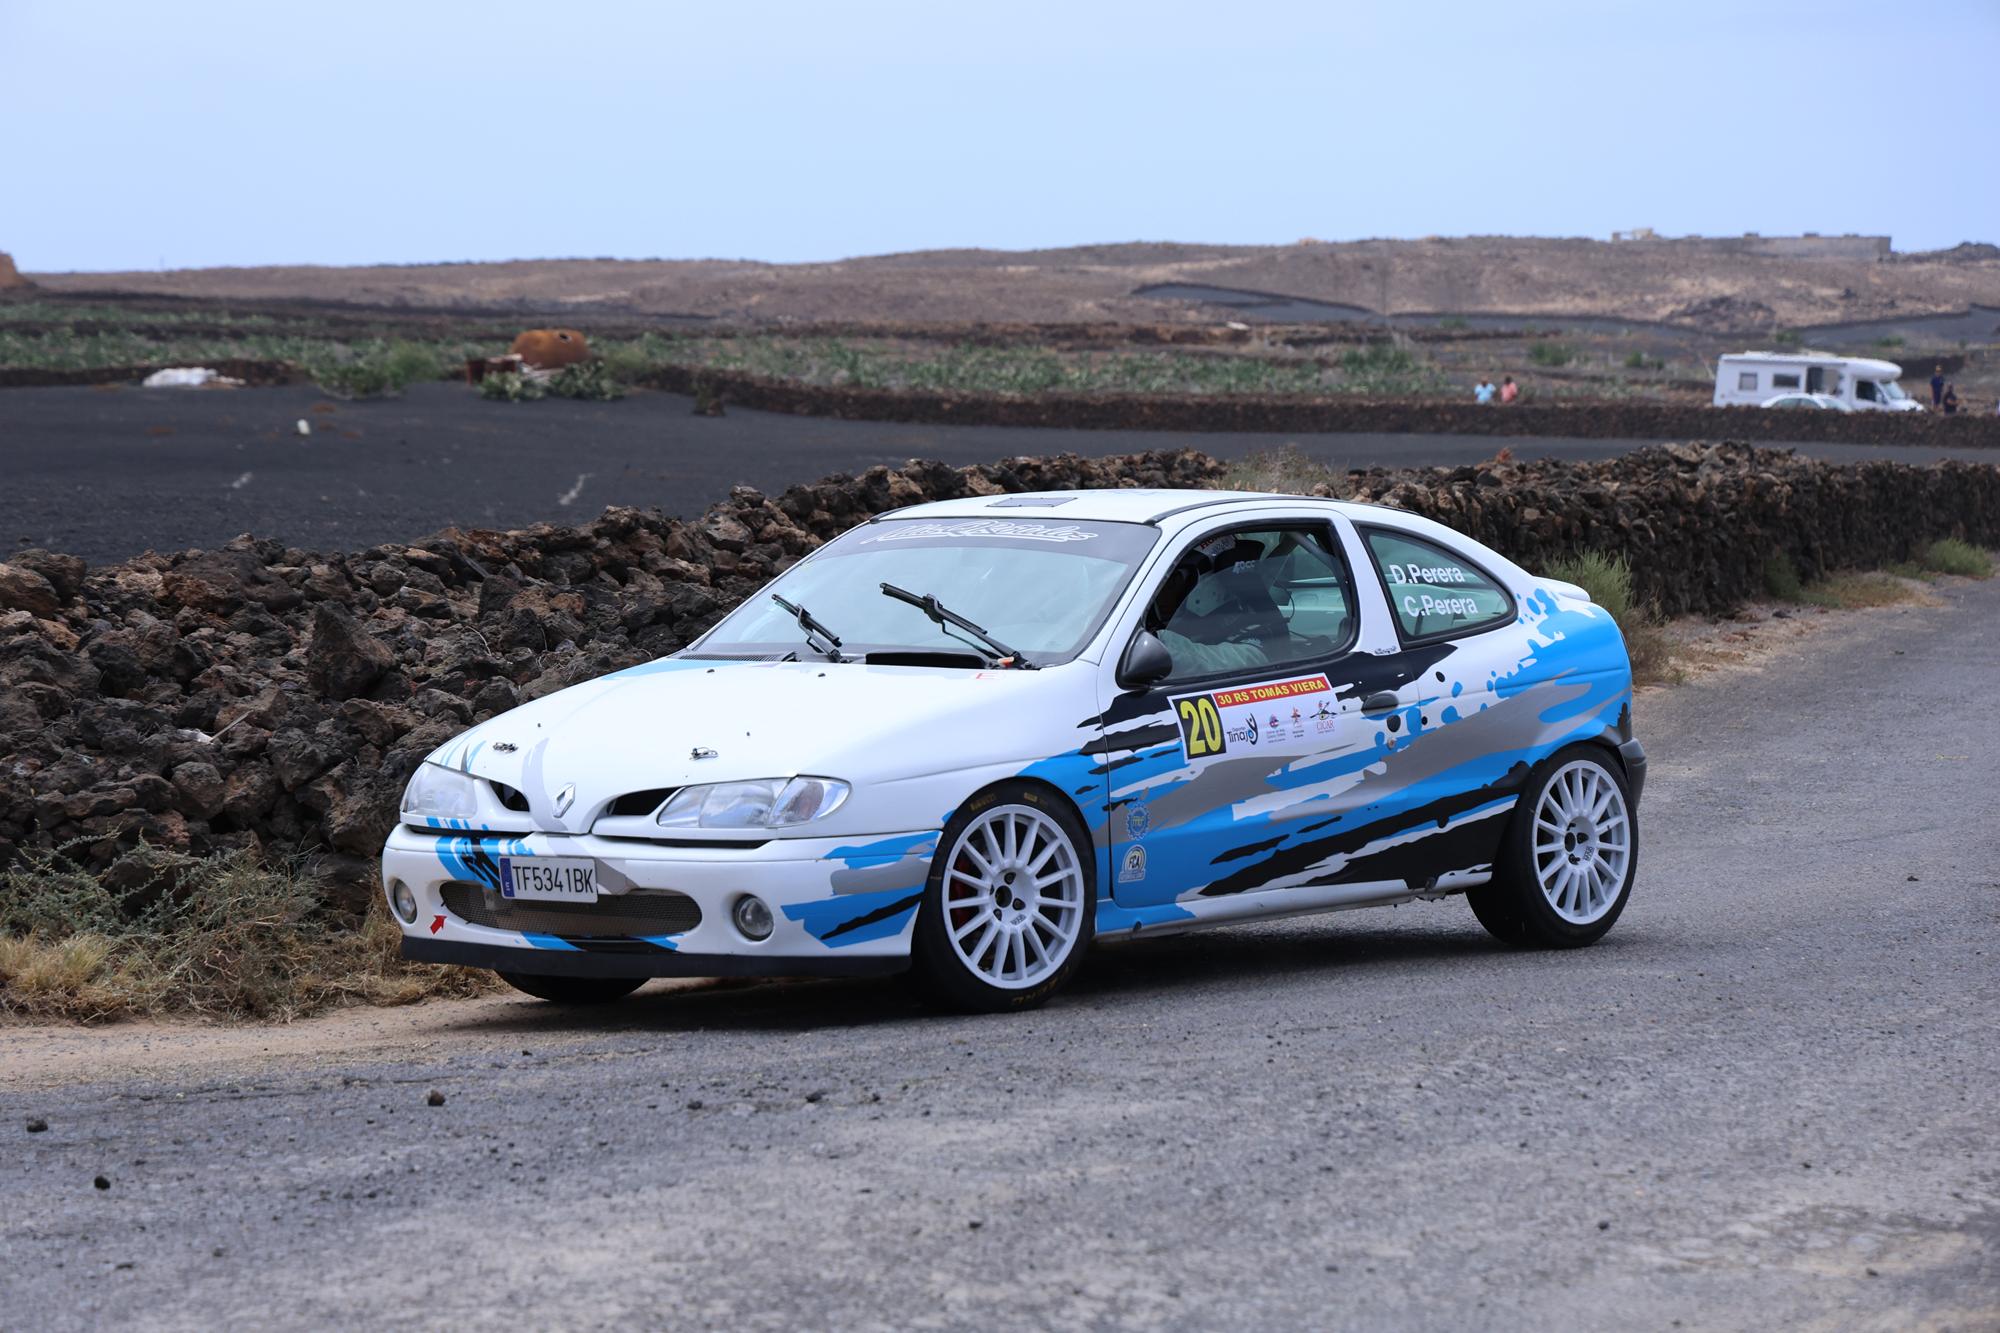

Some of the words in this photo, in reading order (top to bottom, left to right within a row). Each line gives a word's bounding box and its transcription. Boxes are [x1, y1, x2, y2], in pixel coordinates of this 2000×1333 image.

[1389, 564, 1465, 584] D.Perera
[1404, 595, 1479, 618] C.Perera
[1218, 694, 1231, 705] 30
[1234, 690, 1250, 703] RS
[1250, 684, 1289, 699] TOMÁS
[1290, 680, 1325, 693] VIERA
[1180, 698, 1221, 755] 20
[1227, 729, 1254, 743] Tinajo
[512, 867, 593, 893] TF5341BK
